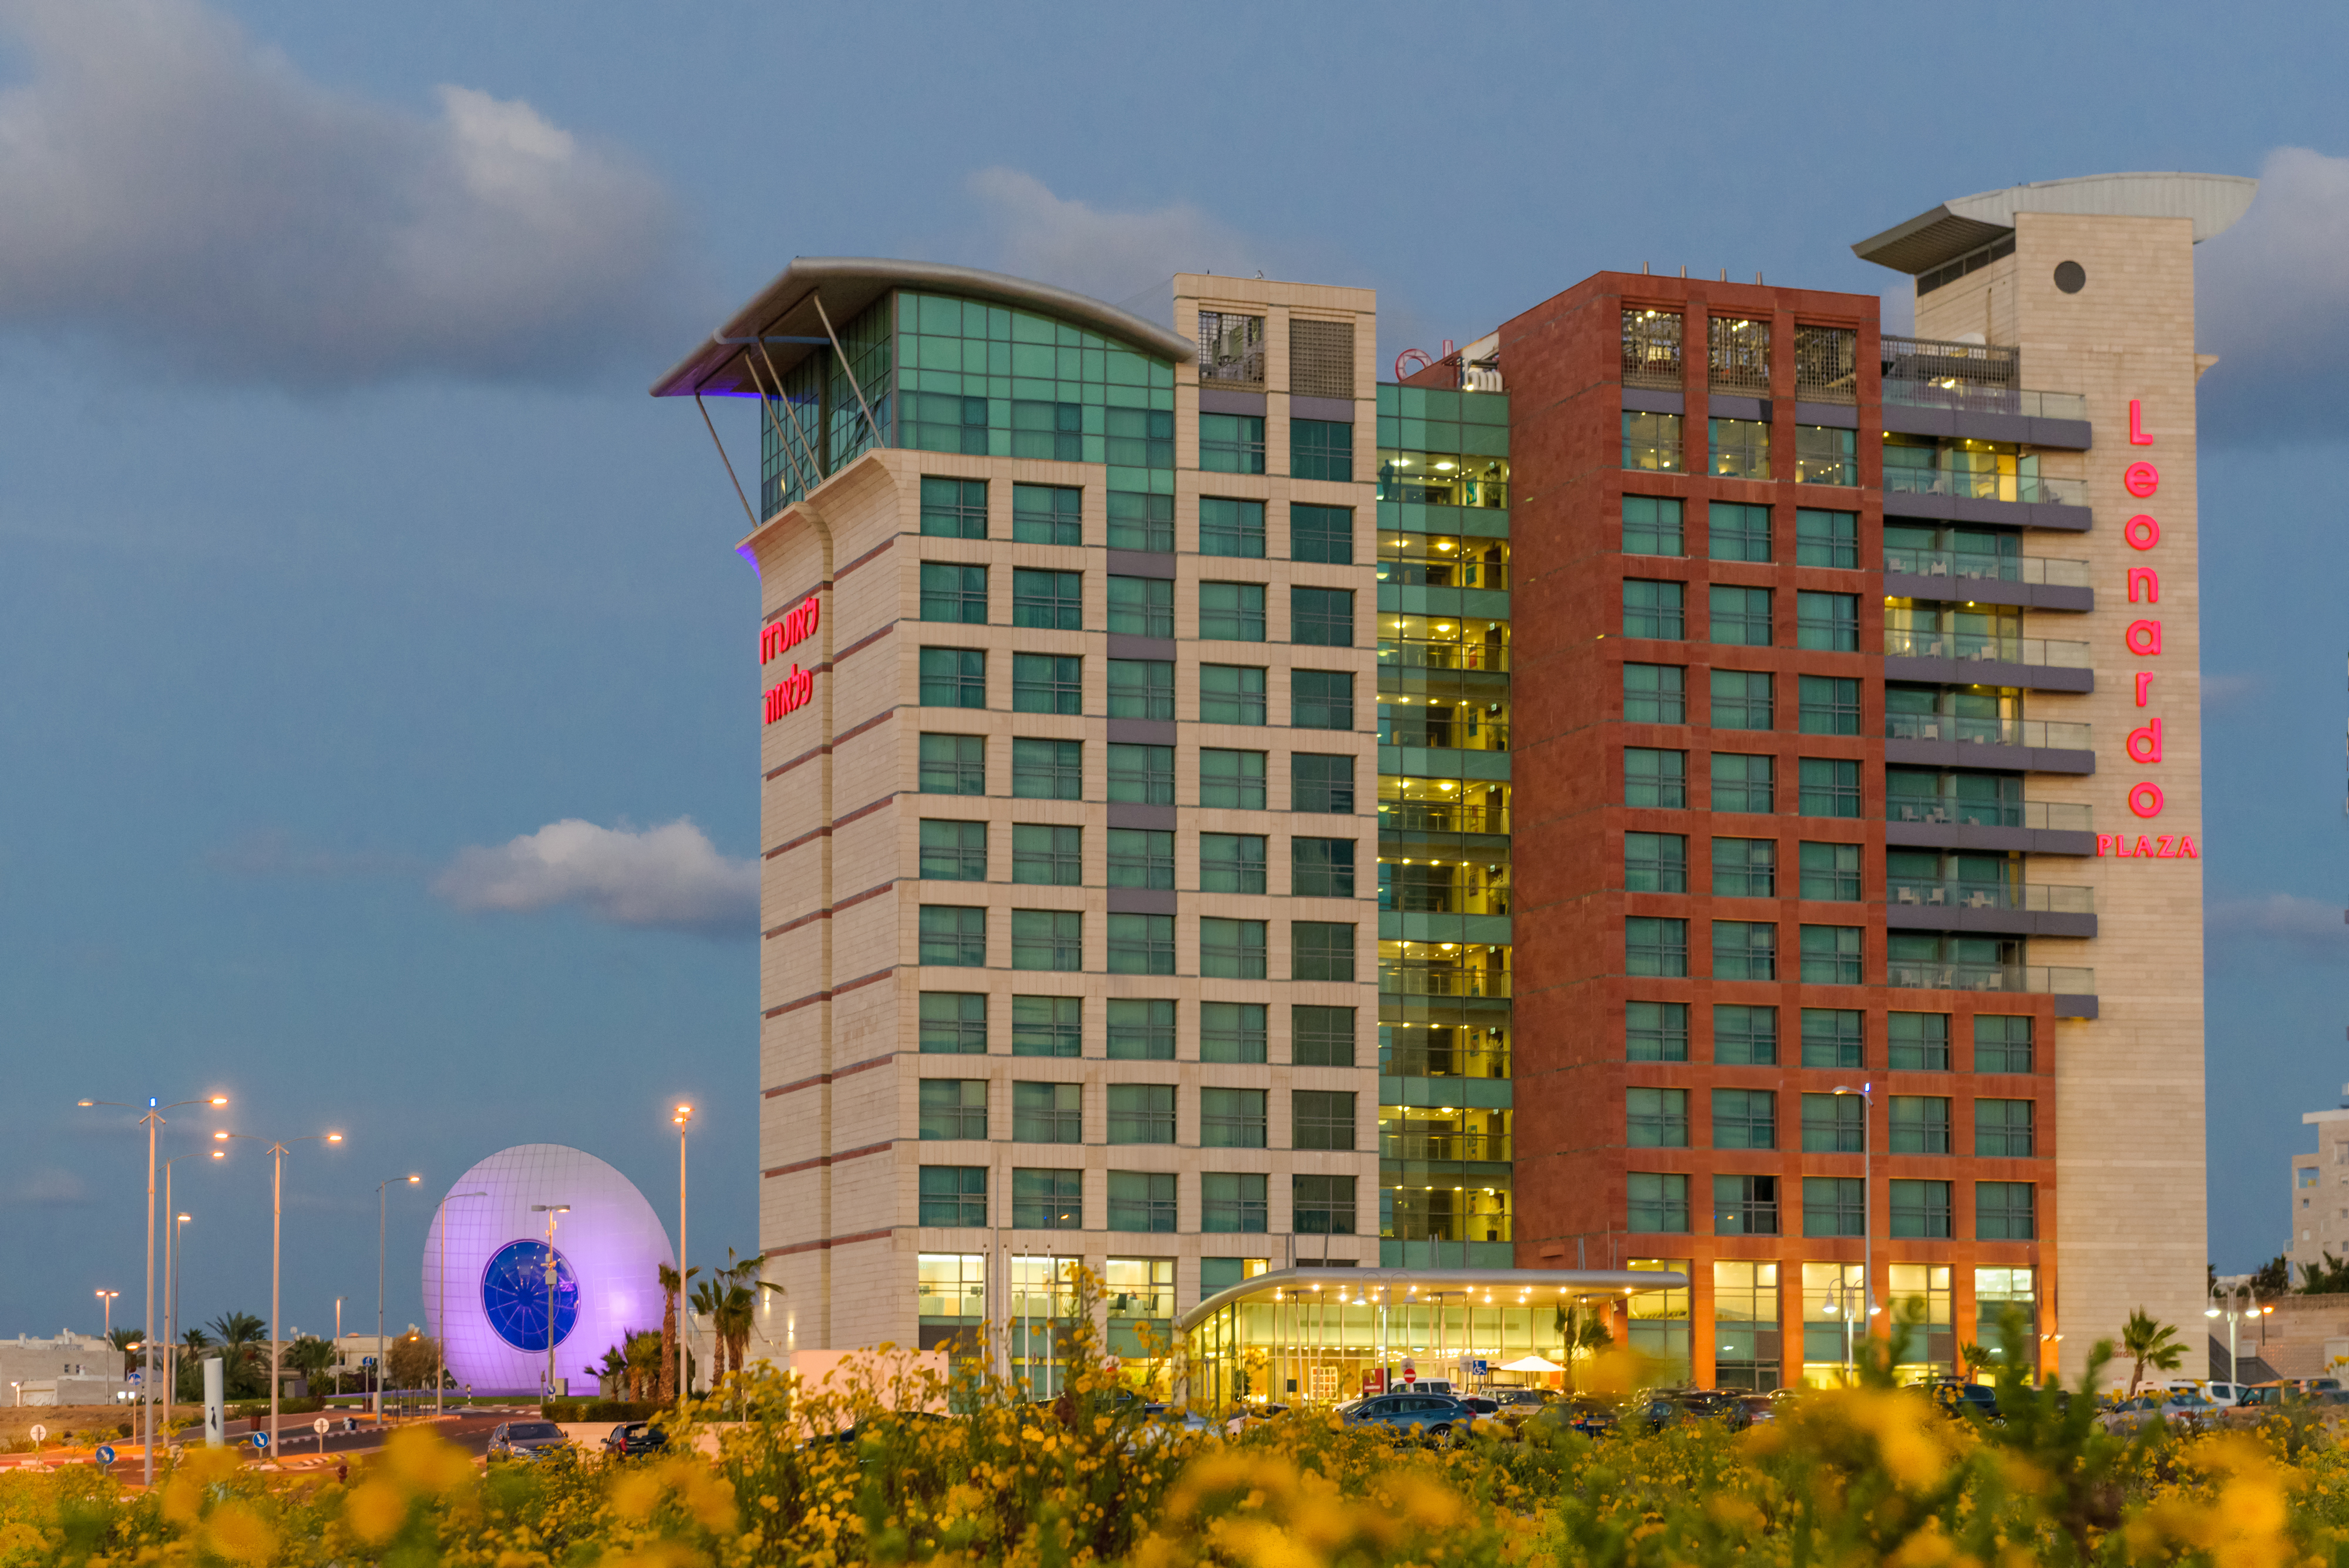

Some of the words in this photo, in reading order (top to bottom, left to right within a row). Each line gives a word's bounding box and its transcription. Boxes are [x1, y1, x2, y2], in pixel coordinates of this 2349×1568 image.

[760, 597, 819, 665] לאונרדו
[2124, 399, 2164, 818] Leonardo
[765, 664, 813, 725] פלאזה
[2097, 834, 2198, 858] PLAZA
